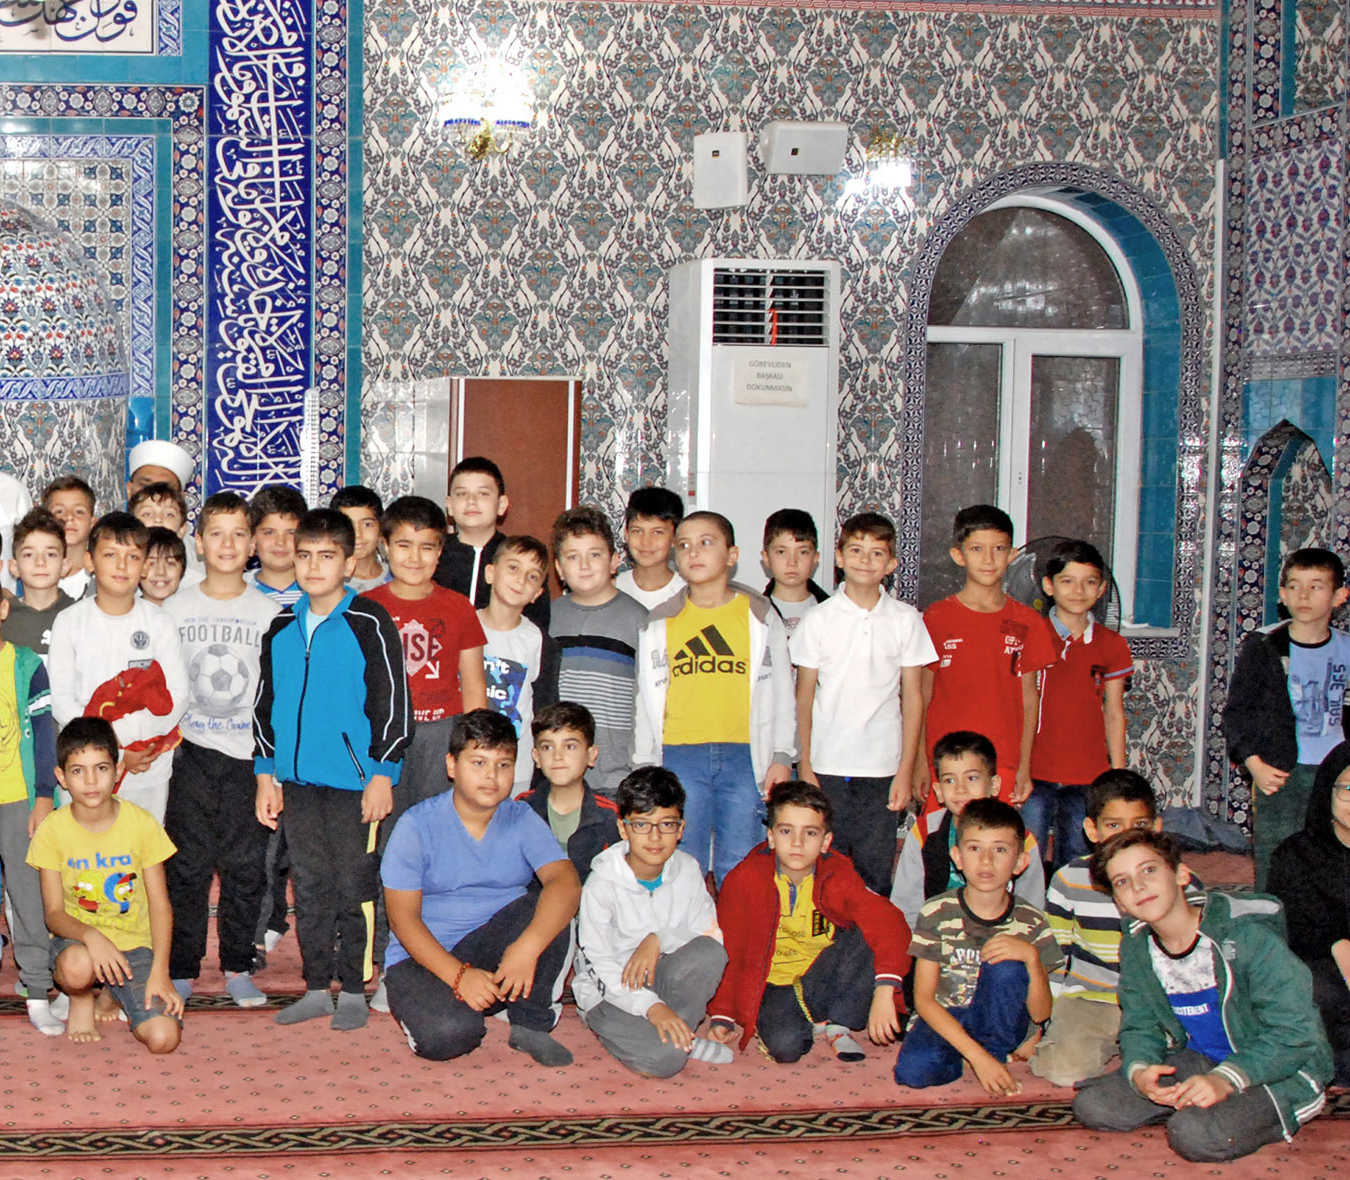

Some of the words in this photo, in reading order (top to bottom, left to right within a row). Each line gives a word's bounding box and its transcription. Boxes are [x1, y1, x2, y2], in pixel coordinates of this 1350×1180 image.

[178, 624, 261, 648] FOOTBALL
[402, 633, 442, 661] ISE
[672, 655, 747, 678] adidas
